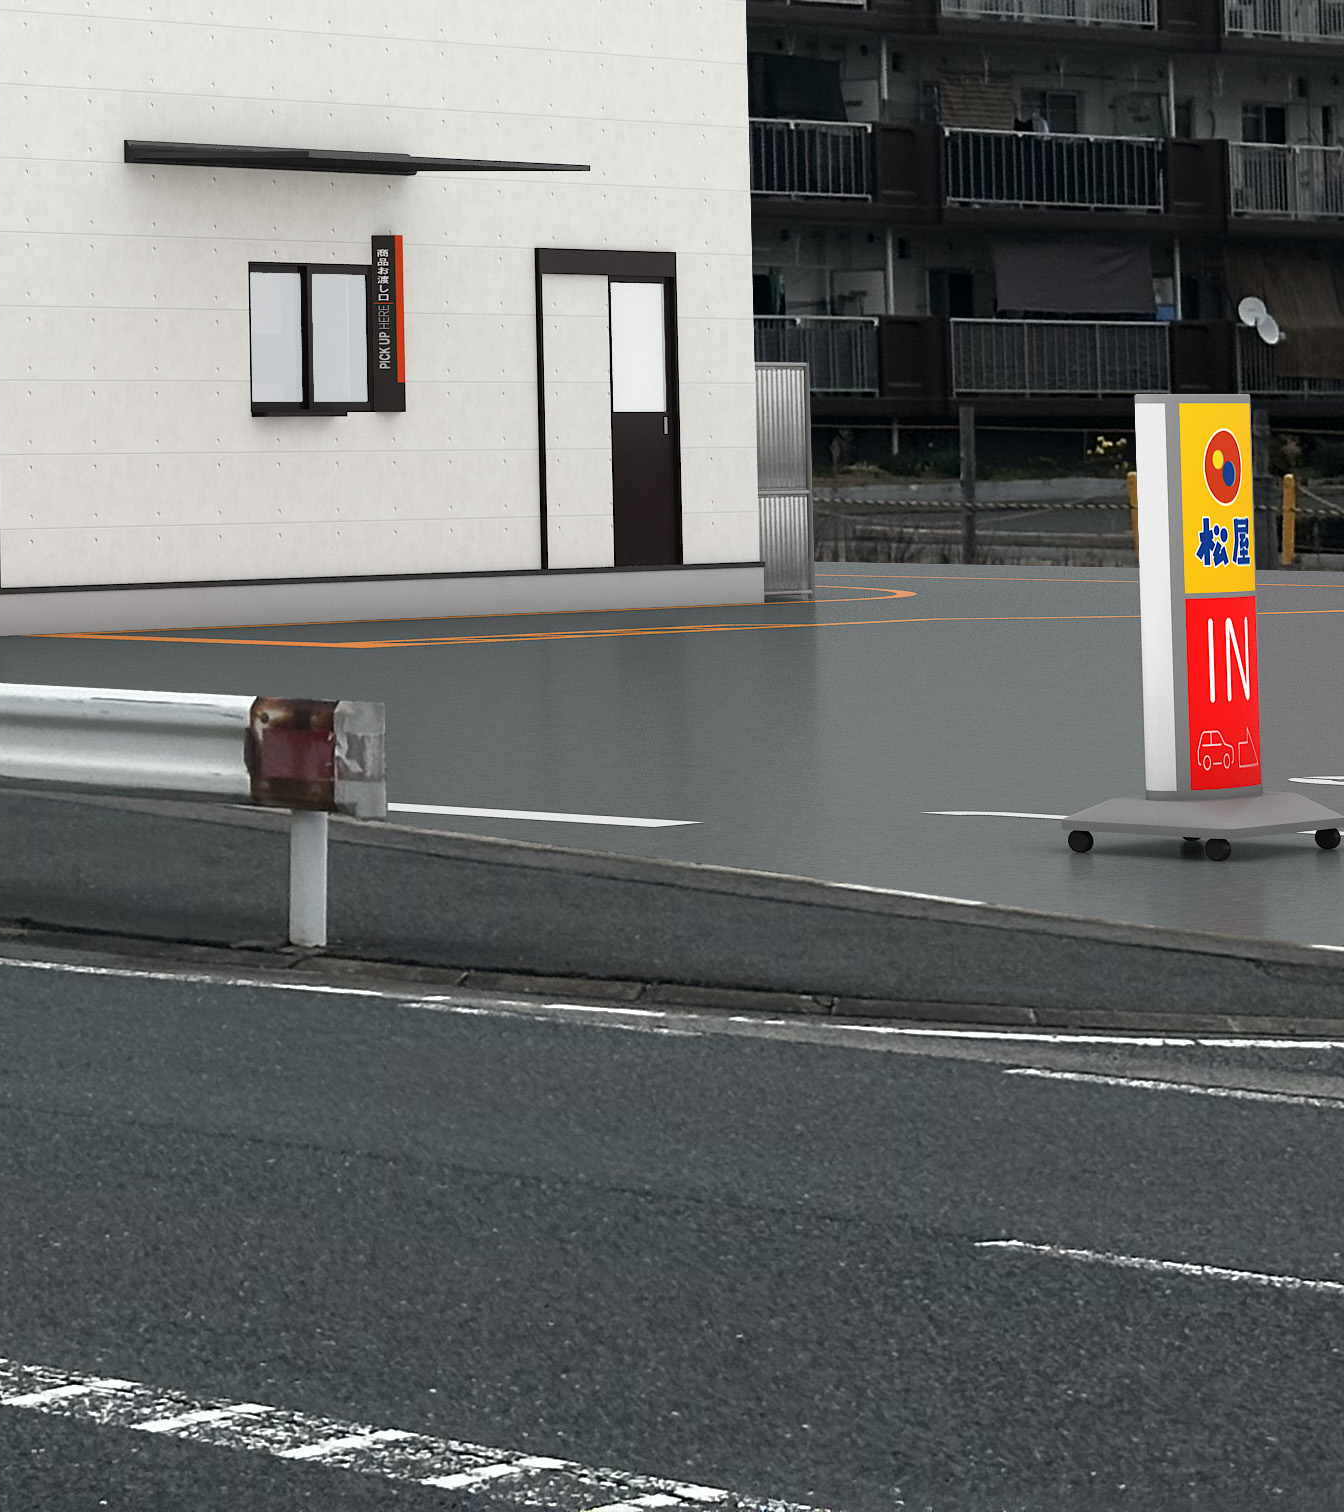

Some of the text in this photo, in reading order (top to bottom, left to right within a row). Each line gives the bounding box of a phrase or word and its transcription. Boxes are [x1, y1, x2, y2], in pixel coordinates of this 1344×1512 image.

[377, 248, 390, 302] 商品お渡し口
[378, 304, 391, 370] PICK UP HERE
[1195, 516, 1252, 567] 松屋
[1207, 615, 1252, 704] IN
